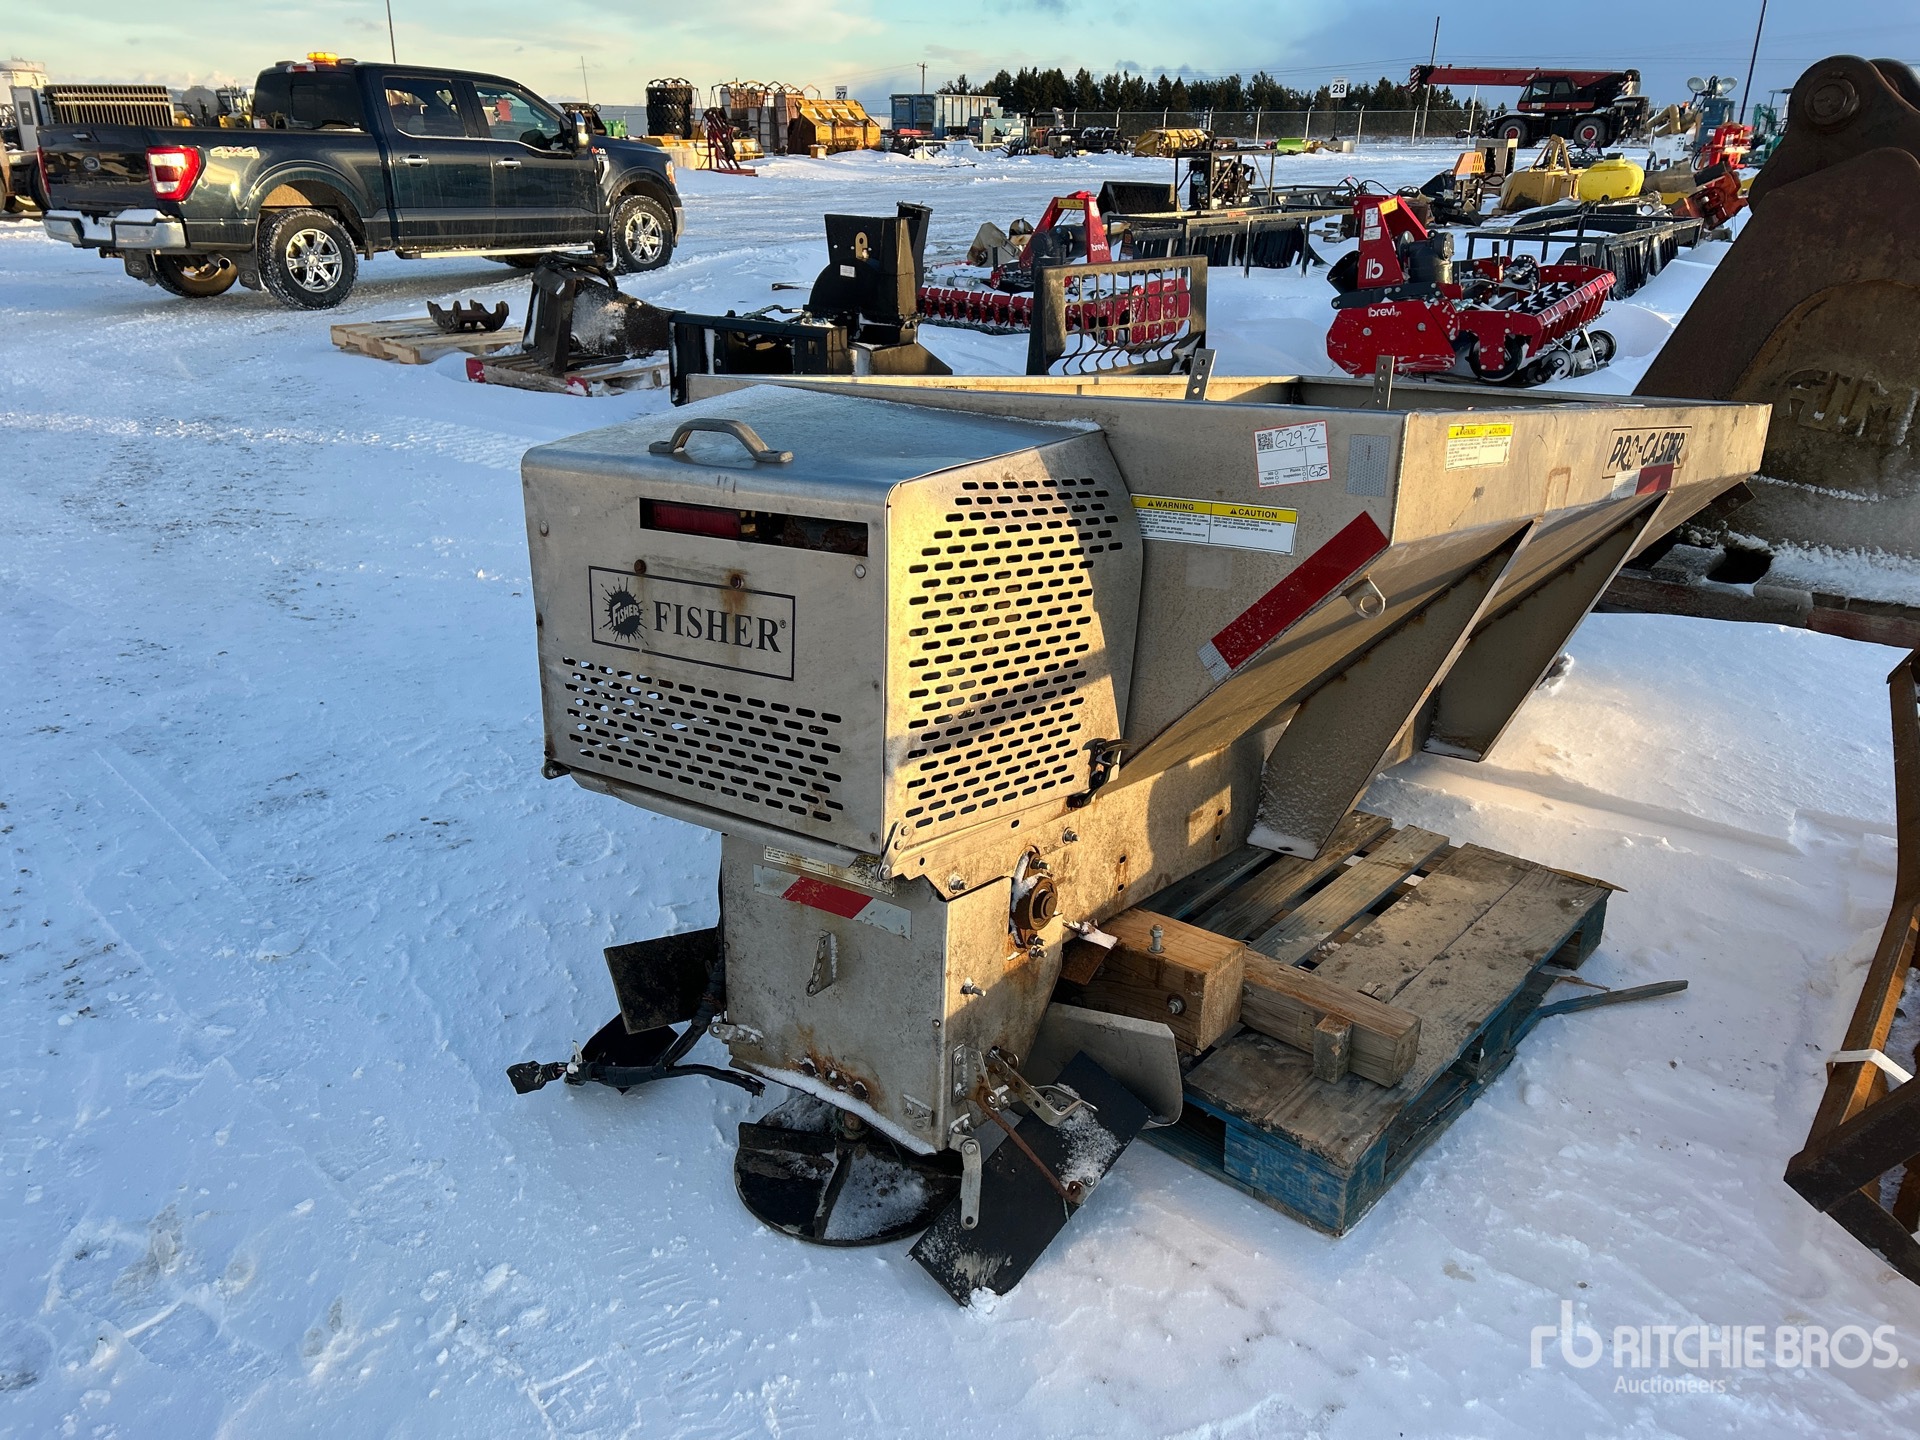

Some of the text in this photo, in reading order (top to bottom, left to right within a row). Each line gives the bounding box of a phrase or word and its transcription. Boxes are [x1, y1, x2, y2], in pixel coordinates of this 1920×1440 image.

[1332, 84, 1345, 93] 28
[836, 91, 846, 99] 27
[1155, 500, 1194, 511] WARNING
[1238, 508, 1278, 519] CAUTION
[612, 601, 640, 627] FISHER
